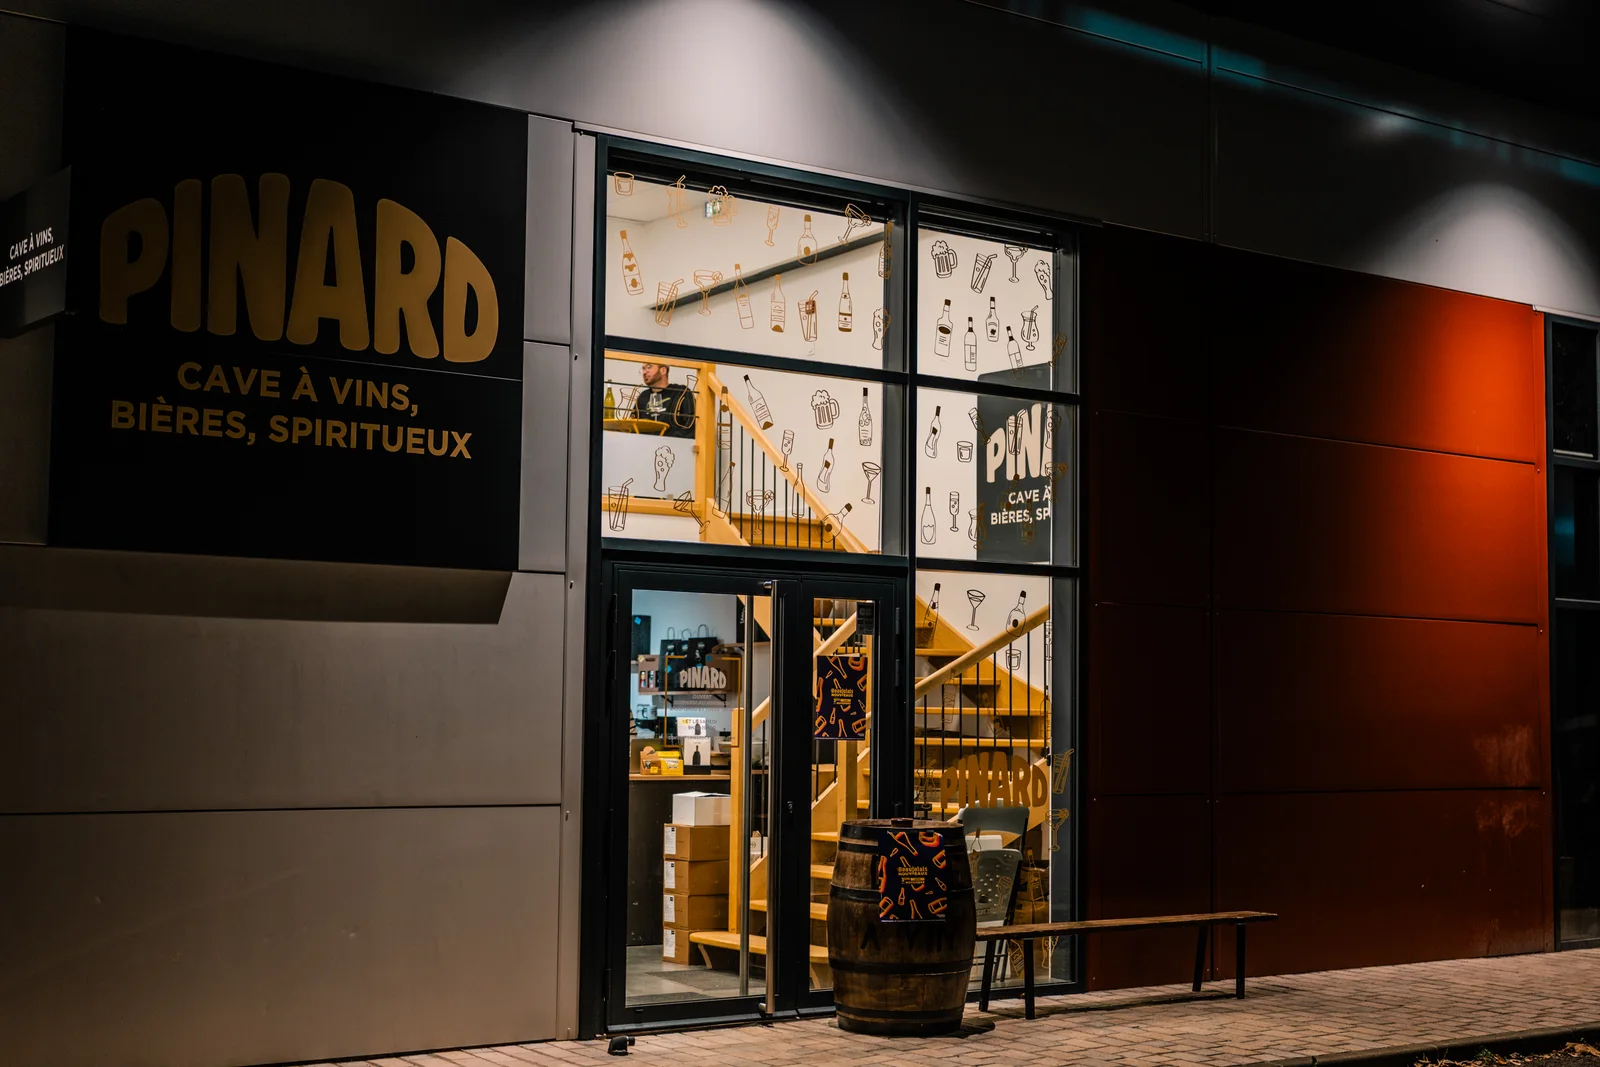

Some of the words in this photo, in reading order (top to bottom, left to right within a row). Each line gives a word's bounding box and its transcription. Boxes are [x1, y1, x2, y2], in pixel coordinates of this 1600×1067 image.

[9, 238, 28, 260] CAVE
[28, 232, 35, 252] À
[35, 227, 54, 248] VINS,
[0, 264, 23, 287] BIÈRES,
[24, 244, 65, 276] SPIRITUEUX
[98, 172, 499, 364] PINARD
[176, 361, 281, 399] CAVE
[292, 365, 319, 403] À
[329, 376, 419, 418] VINS,
[110, 395, 257, 447] BIÈRES,
[268, 414, 473, 460] SPIRITUEUX
[990, 508, 1033, 526] BIÈRES,
[1008, 489, 1040, 504] CAVE
[679, 665, 727, 689] PINARD
[940, 751, 1048, 809] PINARD
